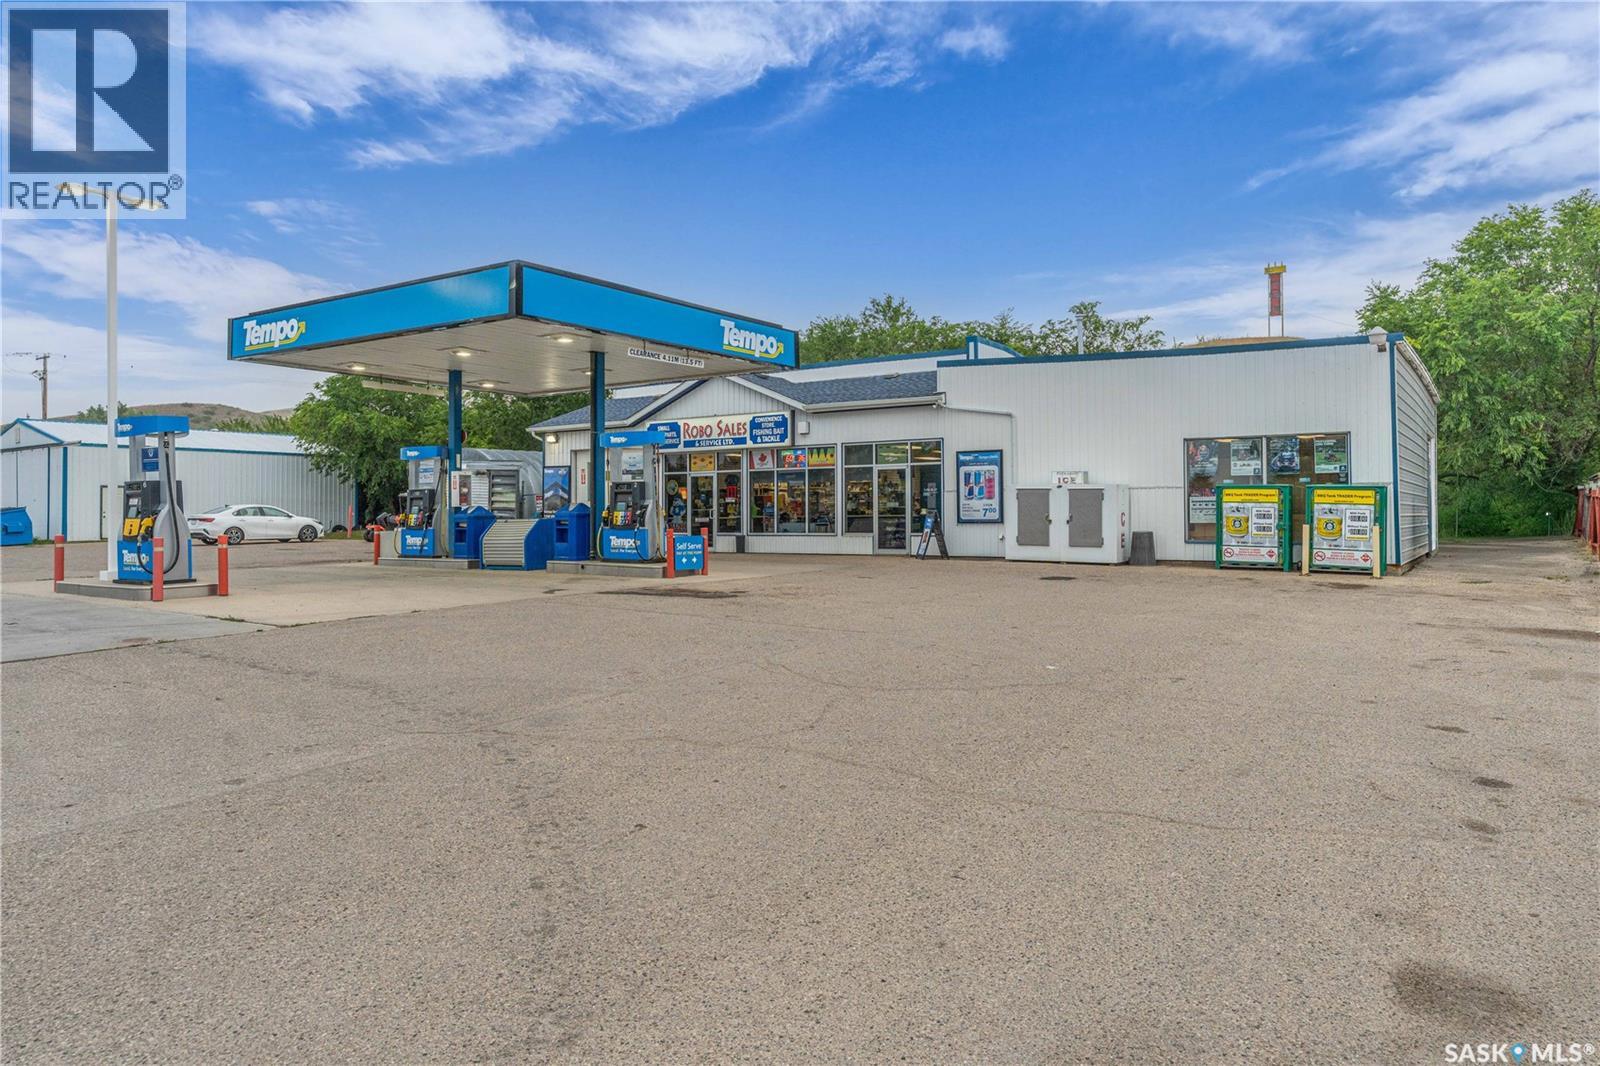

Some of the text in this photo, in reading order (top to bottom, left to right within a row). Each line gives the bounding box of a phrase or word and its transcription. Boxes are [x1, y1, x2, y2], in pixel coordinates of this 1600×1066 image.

[243, 317, 299, 347] Tempo
[720, 318, 777, 357] Tempo
[629, 348, 661, 360] CLEARANCE
[662, 354, 680, 363] 4.11M
[754, 415, 783, 423] CONVENIENCE
[683, 420, 748, 439] ROBO SALES
[752, 427, 785, 436] FISHING BAIT
[700, 439, 722, 447] SERVICE
[723, 438, 735, 446] LTD.
[762, 434, 781, 442] TACKLE
[609, 535, 636, 549] Tempo
[676, 542, 702, 550] Self Serve
